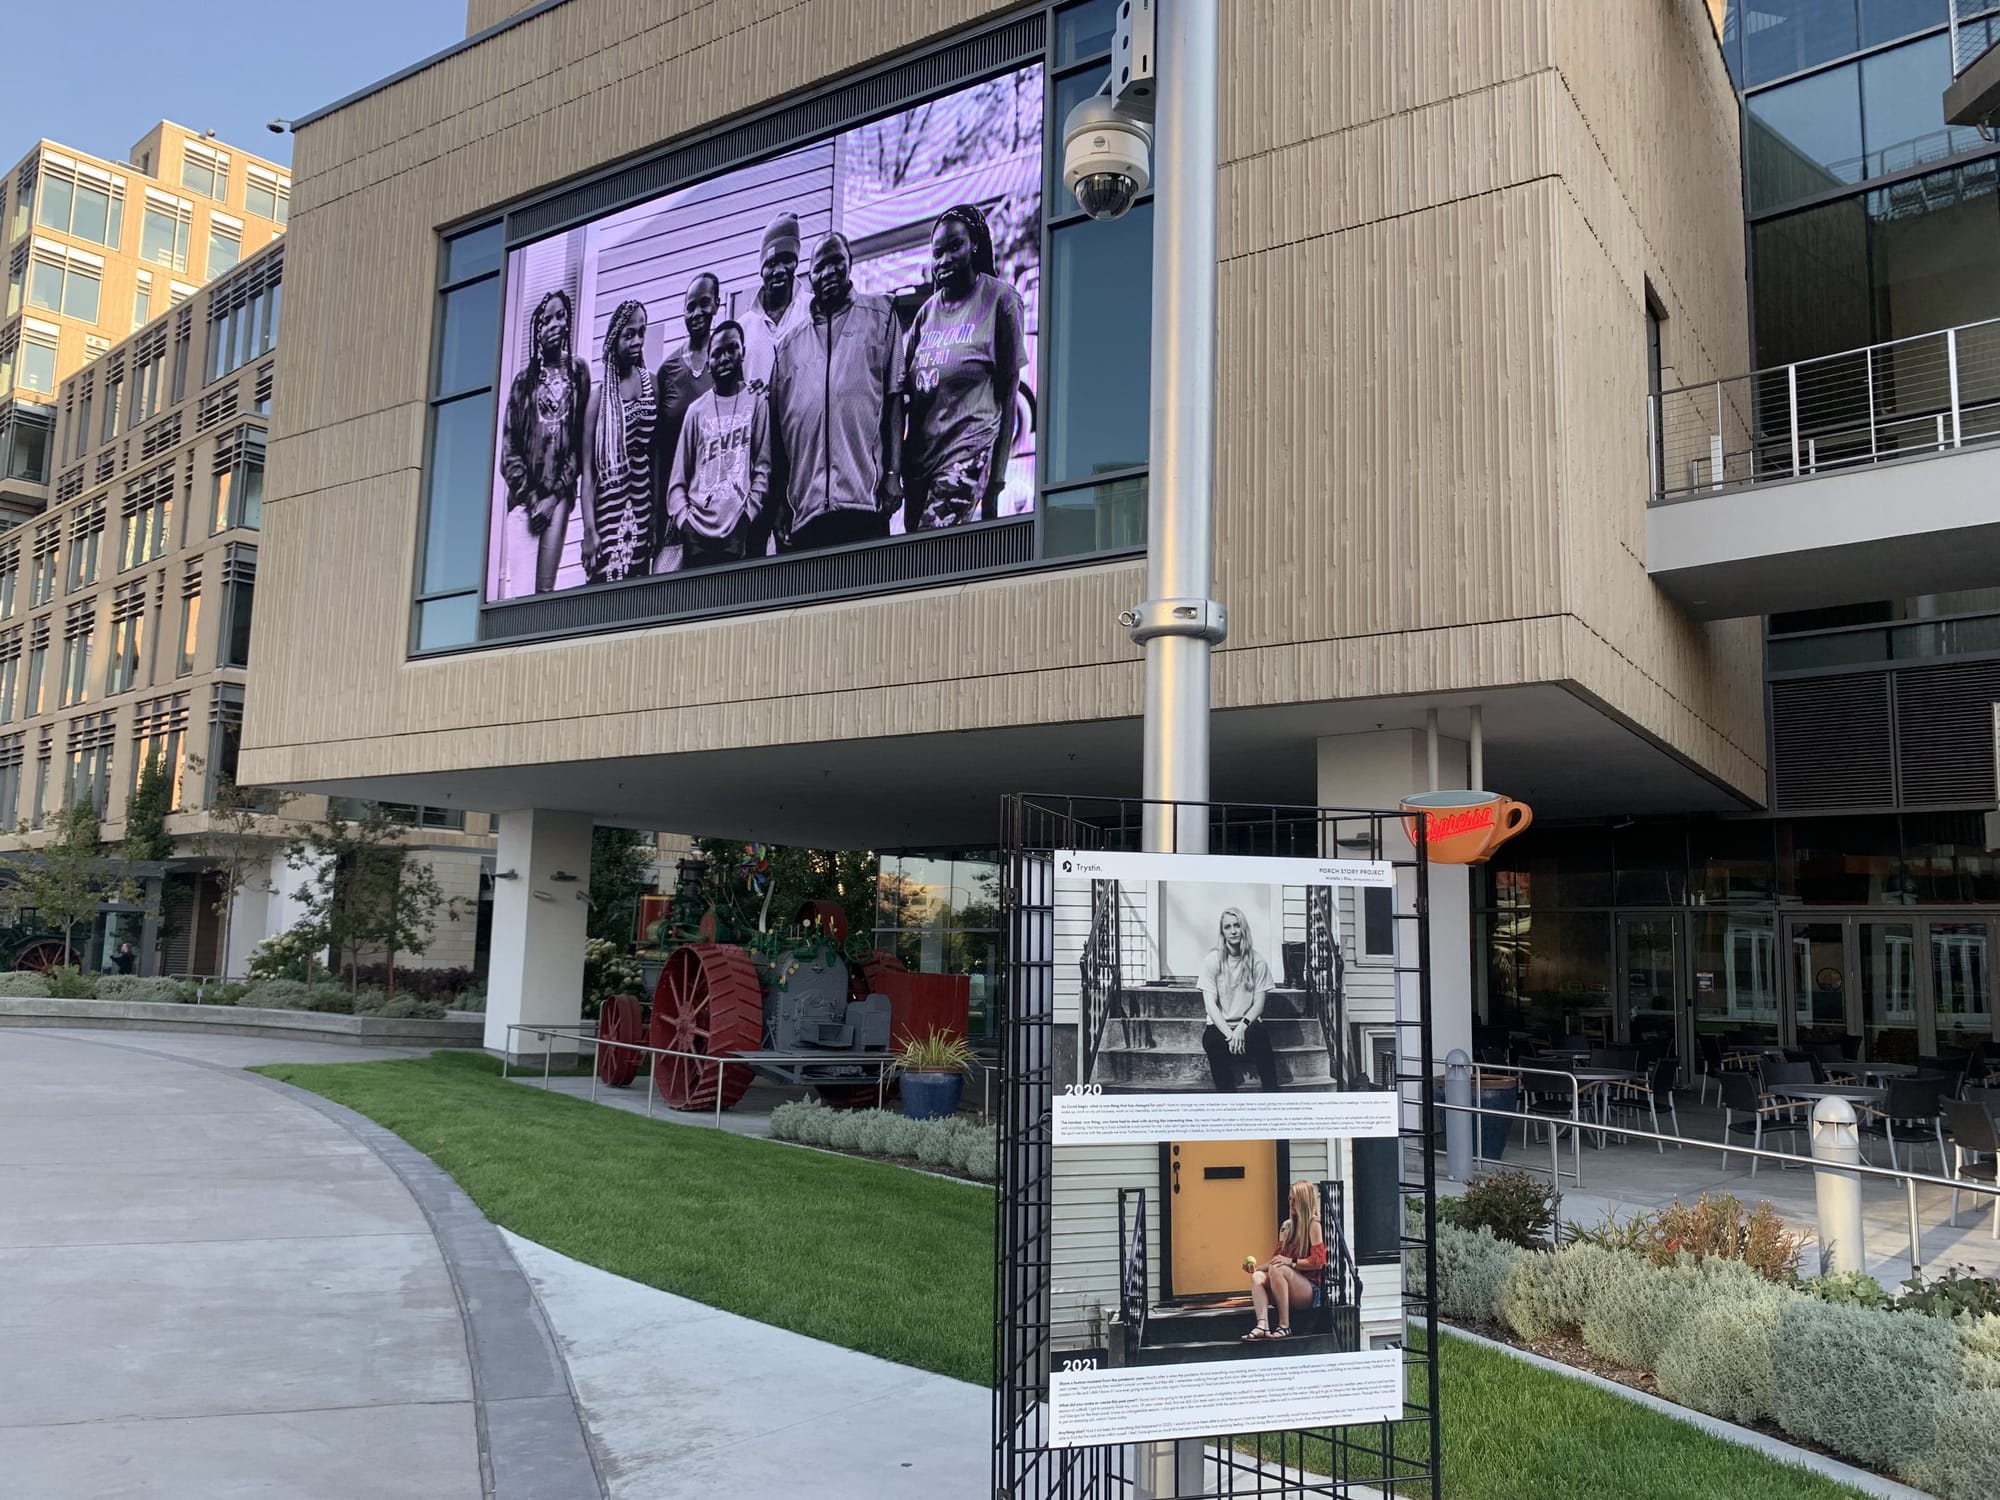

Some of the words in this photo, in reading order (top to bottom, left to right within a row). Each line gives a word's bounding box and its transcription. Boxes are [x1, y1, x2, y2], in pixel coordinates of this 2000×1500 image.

[1411, 807, 1494, 843] Espresso
[1064, 1083, 1103, 1096] 2020
[1062, 1358, 1097, 1373] 2021
